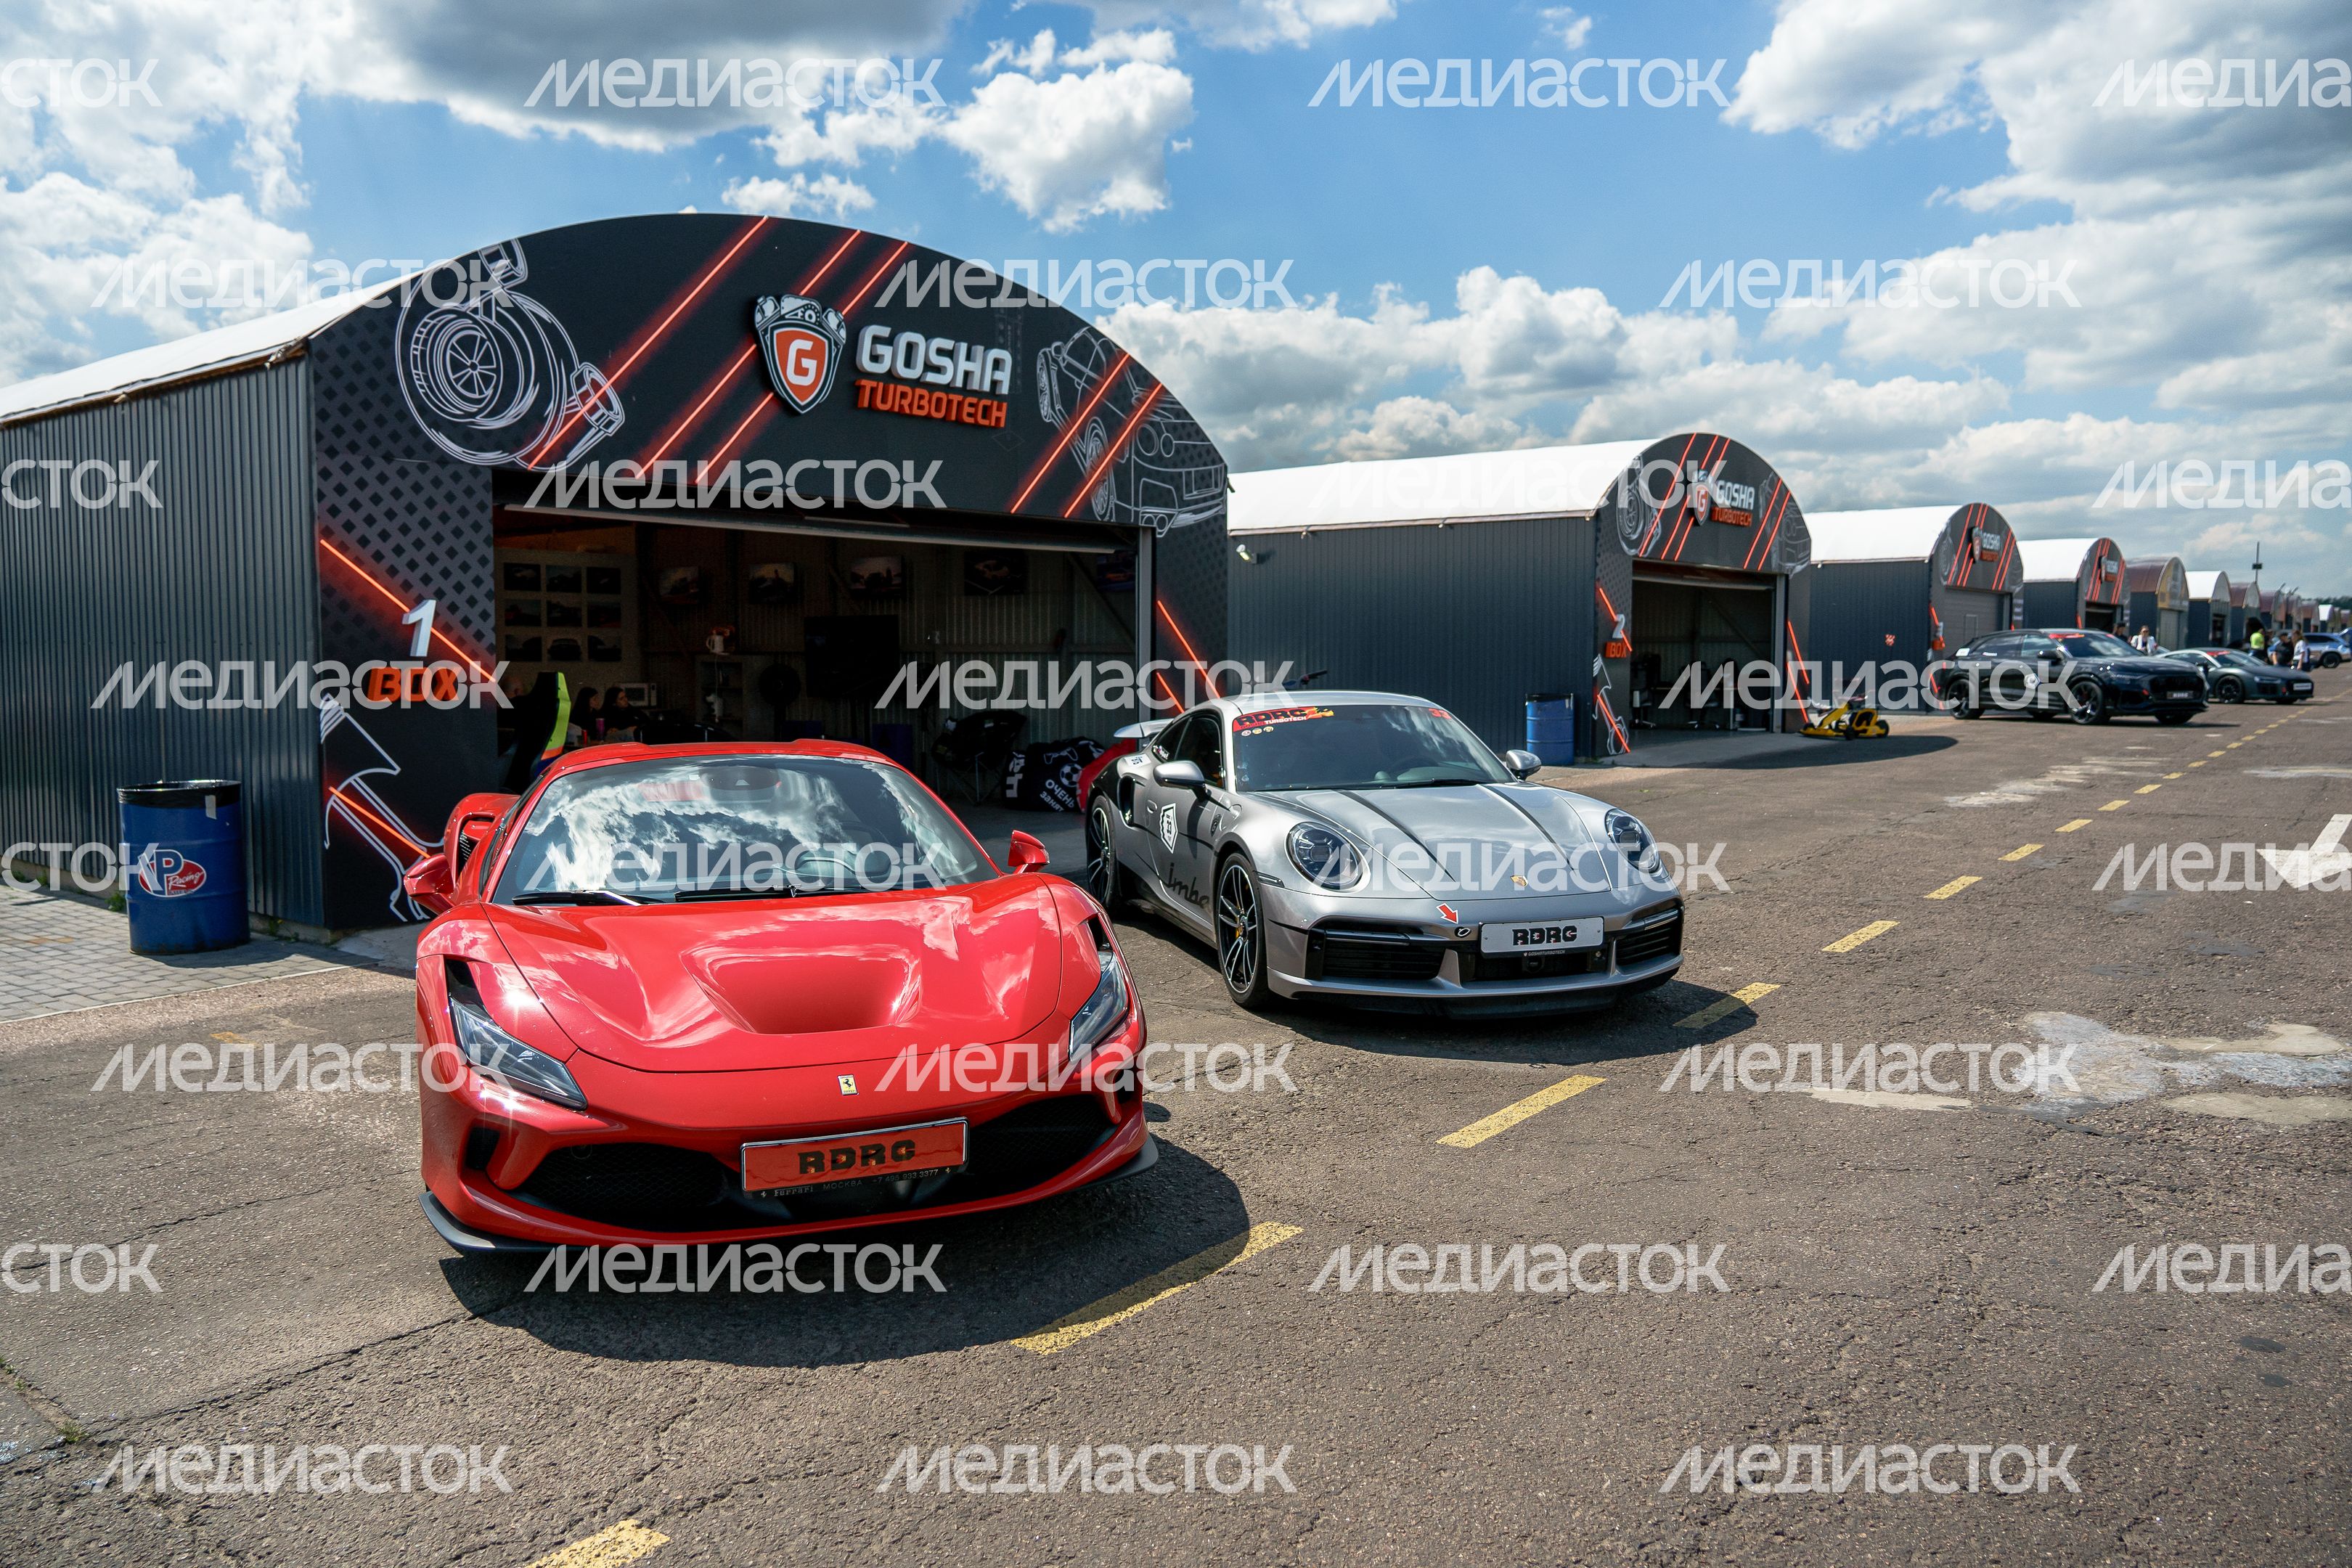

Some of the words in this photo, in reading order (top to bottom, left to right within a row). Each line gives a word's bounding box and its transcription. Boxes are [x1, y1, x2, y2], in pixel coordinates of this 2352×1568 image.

[856, 324, 1013, 395] GOSHA
[855, 379, 1008, 428] TURBOTECH
[1715, 480, 1755, 510] GOSHA
[1711, 507, 1752, 527] TURBOTECH
[402, 599, 437, 657] 1
[1612, 614, 1625, 639] 2
[1604, 642, 1627, 658] BOX
[367, 666, 463, 702] BOX
[1045, 779, 1074, 808] ОЧЕНЬ
[168, 872, 204, 890] Racing
[1512, 925, 1577, 946] RDRC
[798, 1139, 915, 1175] RDRC
[774, 1185, 814, 1197] Ferrari
[823, 1180, 862, 1191] МОСКВА
[919, 1169, 939, 1178] 3377
